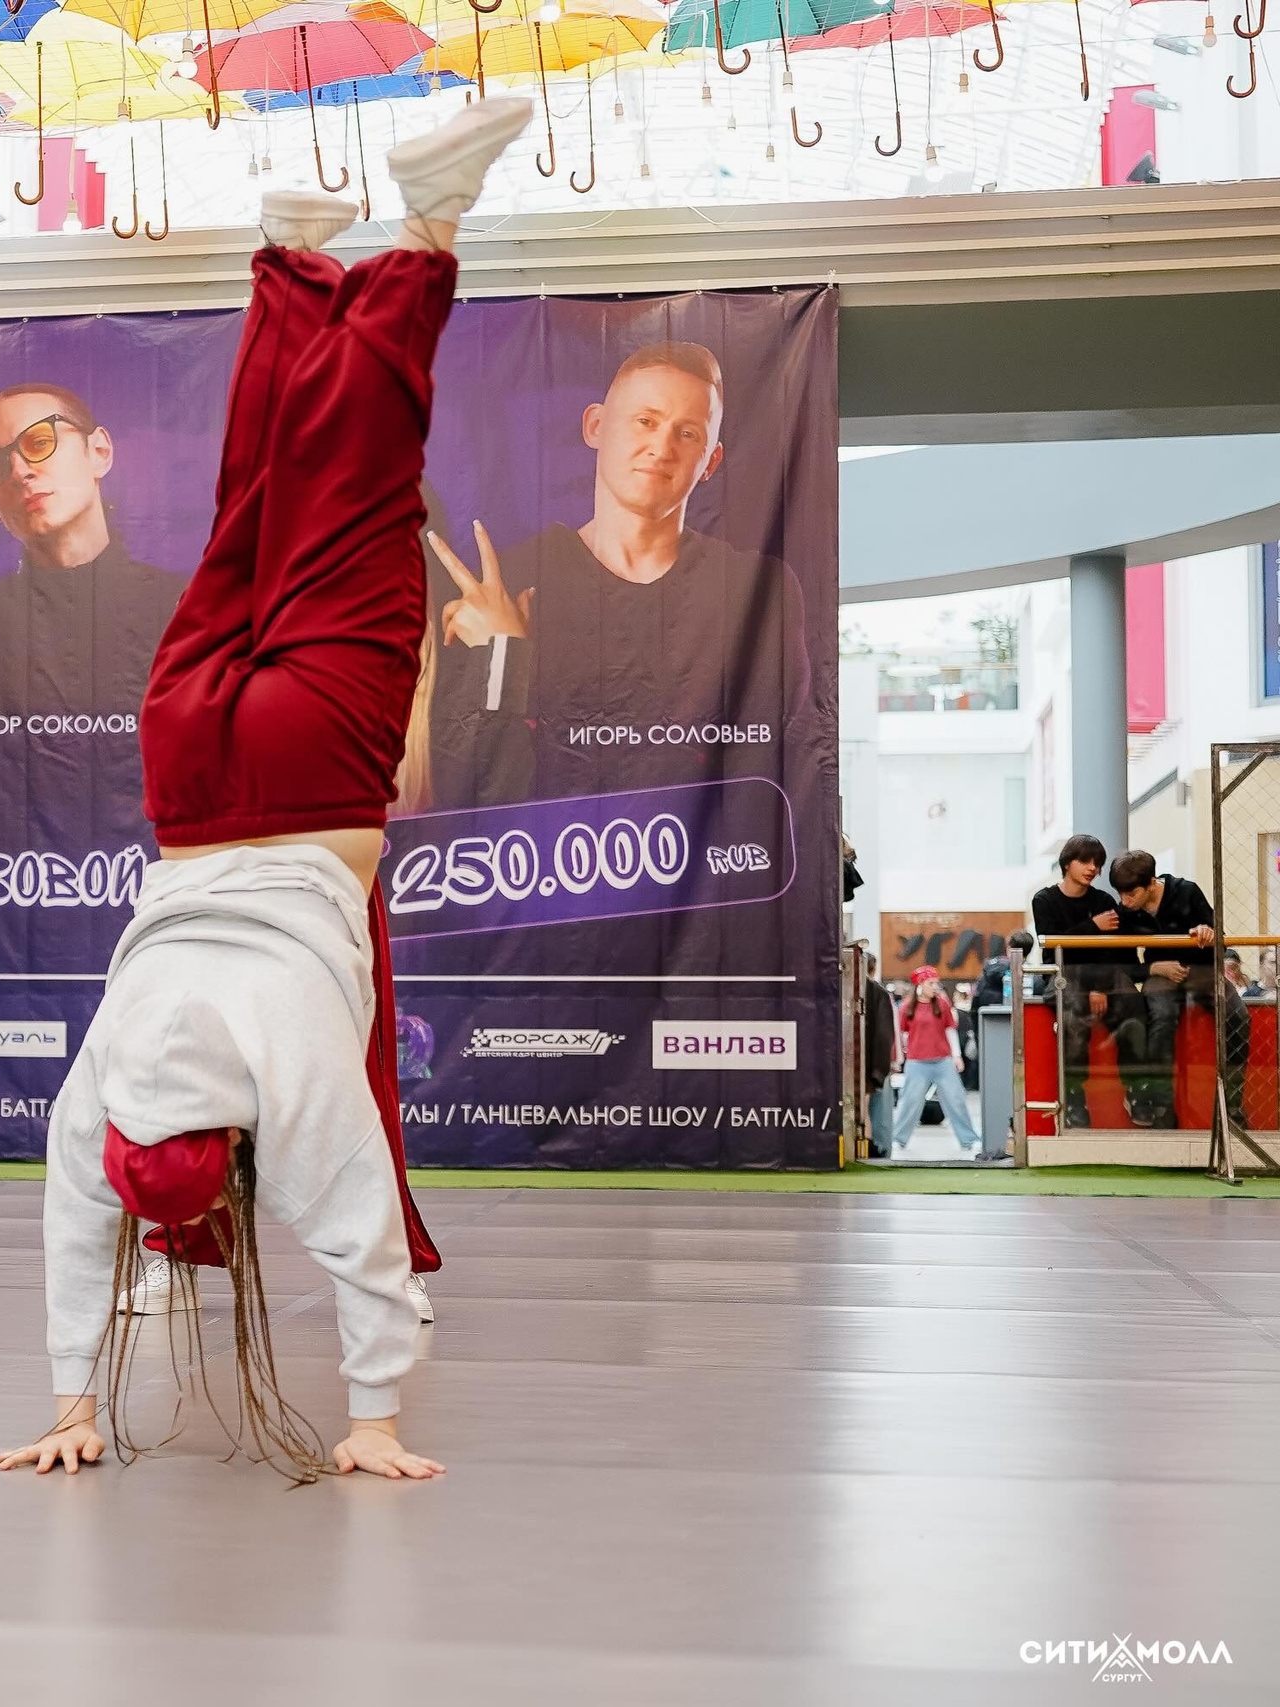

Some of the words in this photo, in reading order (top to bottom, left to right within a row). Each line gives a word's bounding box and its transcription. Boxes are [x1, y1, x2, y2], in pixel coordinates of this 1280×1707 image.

[26, 713, 138, 735] СОКОЛОВ
[569, 725, 641, 746] ИГОРЬ
[647, 723, 772, 745] СОЛОВЬЕВ
[389, 812, 689, 915] 250.000
[706, 843, 771, 876] RUB
[494, 1034, 591, 1045] ФОРСАЖ
[663, 1036, 786, 1054] ванлав
[460, 1104, 641, 1128] ТАНЦЕВАЛЬНОЕ
[648, 1106, 707, 1128] ШОУ
[730, 1106, 814, 1129] БАТТЛЫ
